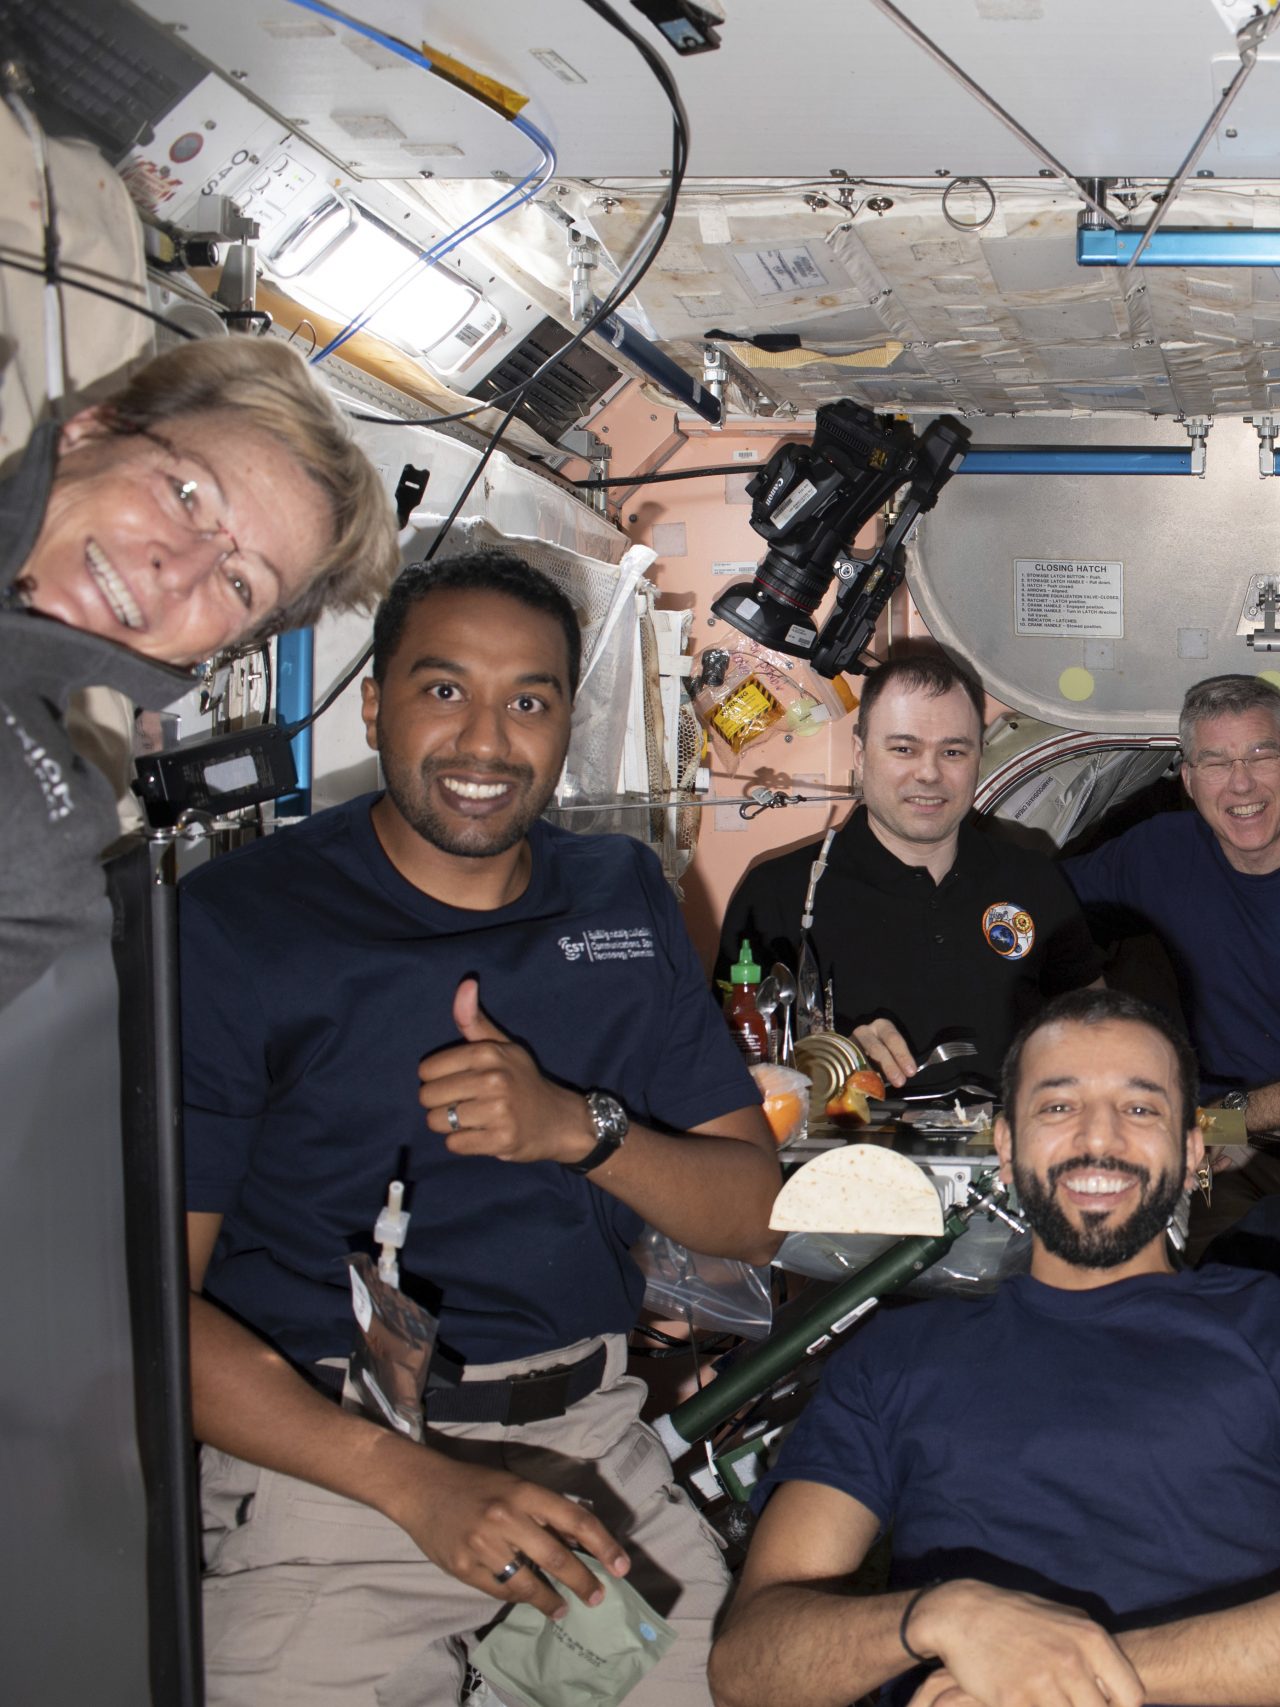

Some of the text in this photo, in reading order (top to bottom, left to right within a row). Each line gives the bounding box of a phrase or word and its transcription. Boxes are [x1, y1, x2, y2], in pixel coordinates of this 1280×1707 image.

[765, 477, 784, 506] Canon
[1035, 564, 1107, 573] CLOSING HATCH
[1014, 804, 1028, 820] CREAM
[565, 943, 585, 953] CST
